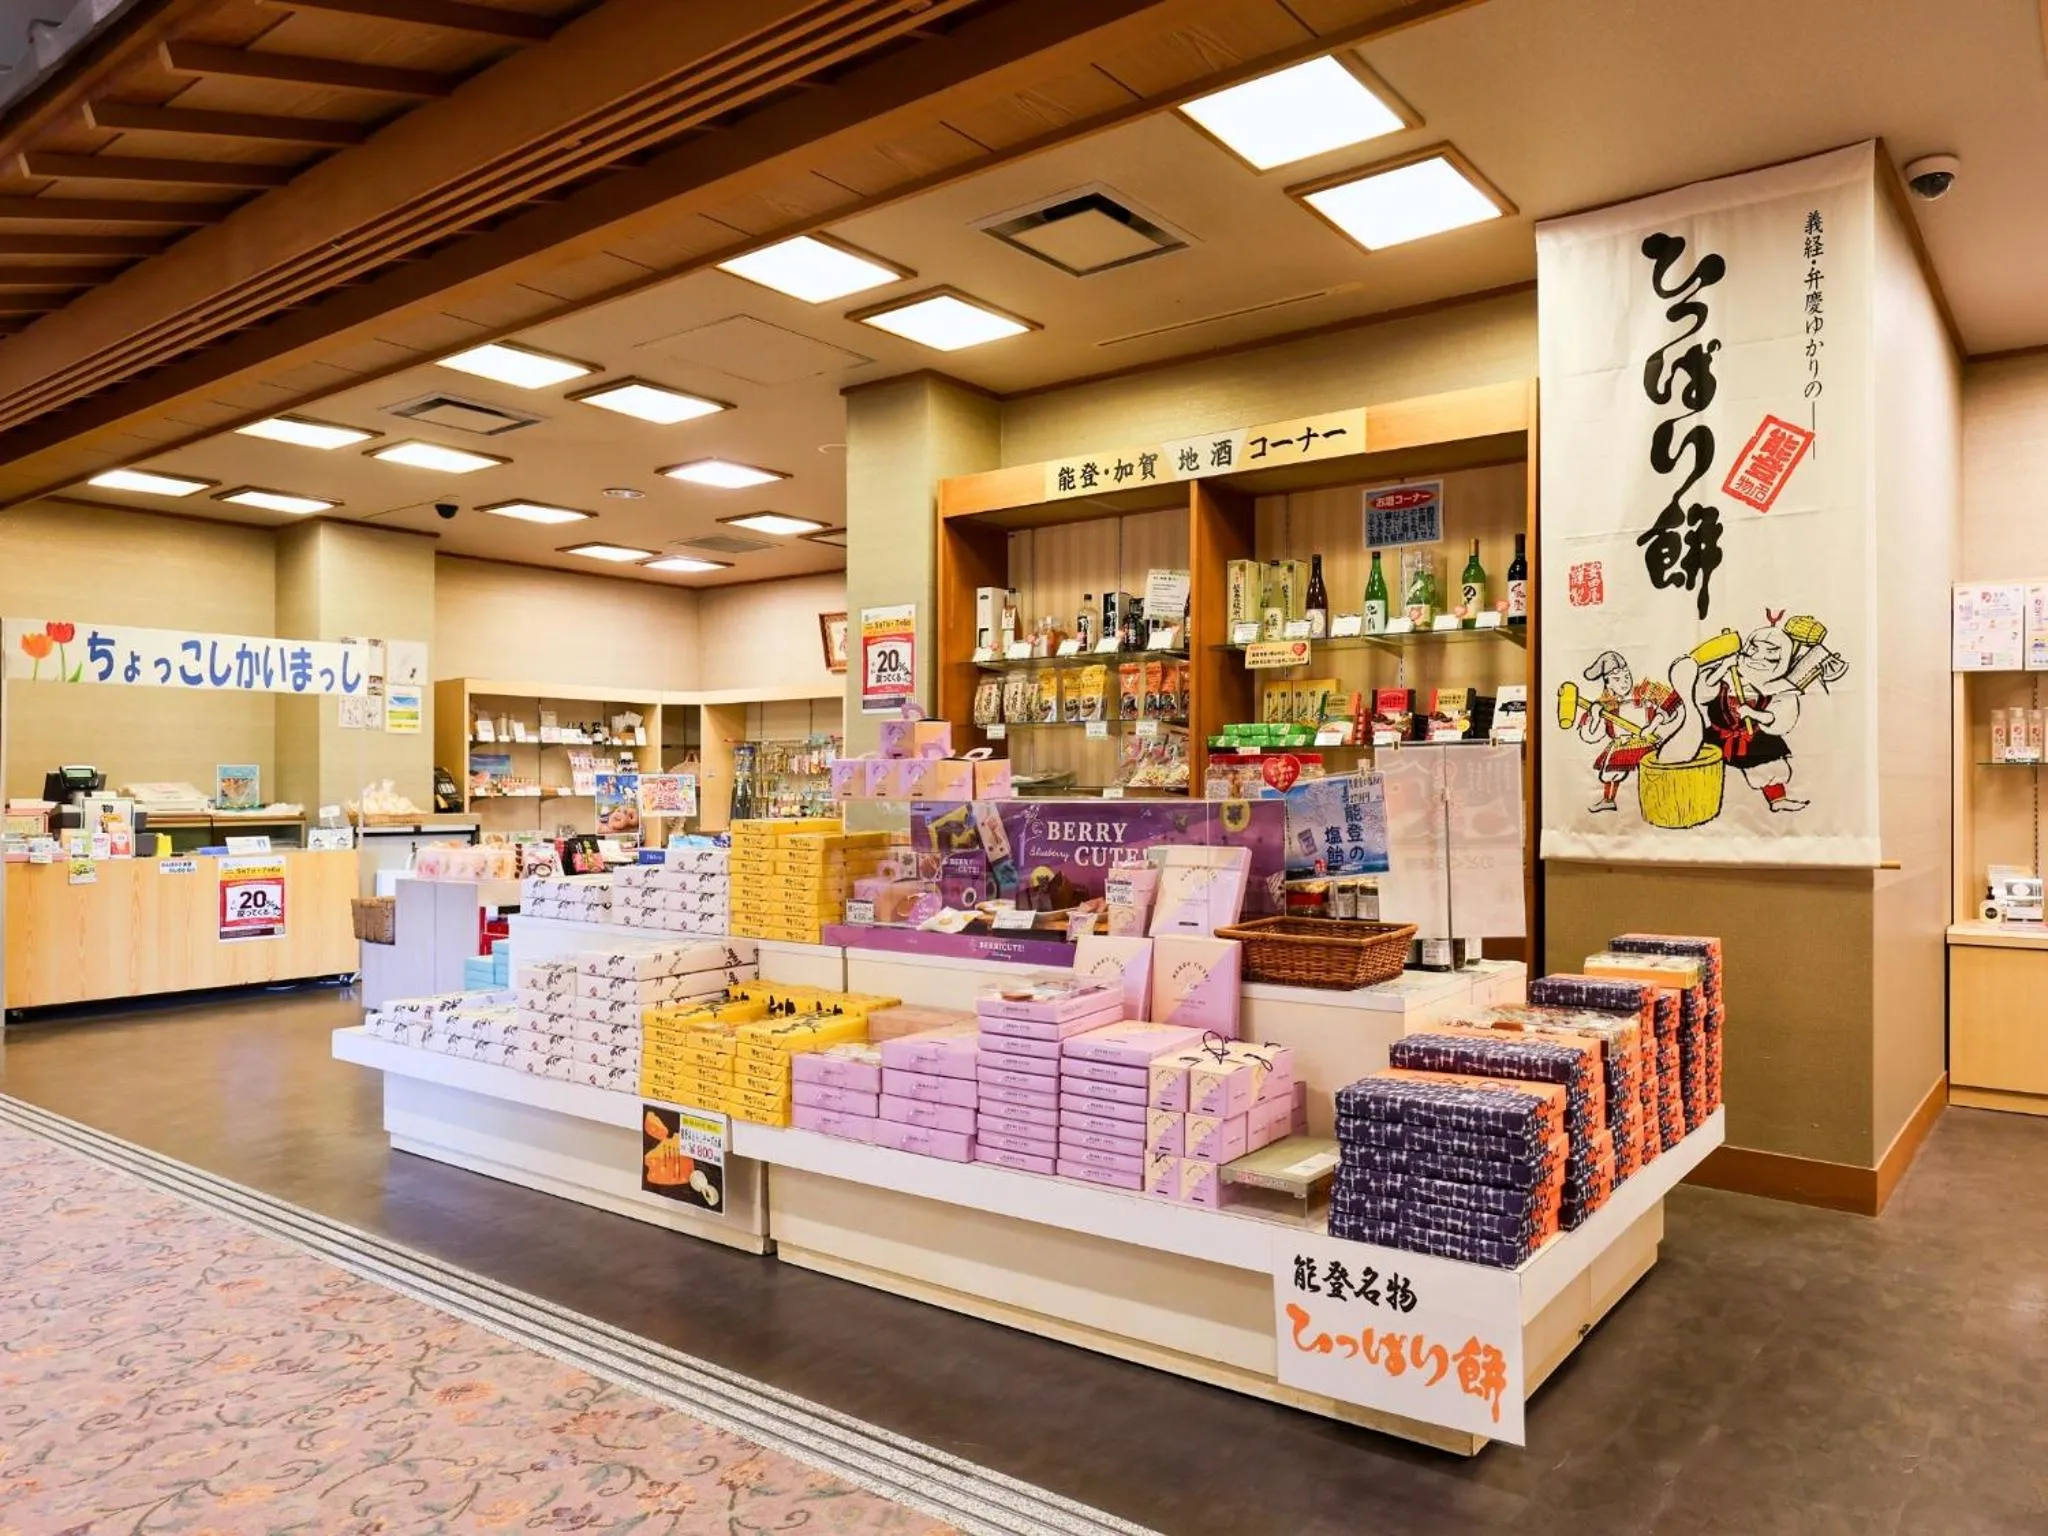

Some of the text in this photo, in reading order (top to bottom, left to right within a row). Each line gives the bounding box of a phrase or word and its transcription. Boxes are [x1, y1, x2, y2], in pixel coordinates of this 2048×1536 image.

[1057, 424, 1349, 492] 能登・加賀 地酒 コーナー
[86, 629, 362, 694] ちょっこしかいまっし
[1047, 821, 1128, 842] BERRY
[1324, 826, 1344, 867] 塩飴
[1293, 1253, 1419, 1313] 能登名物
